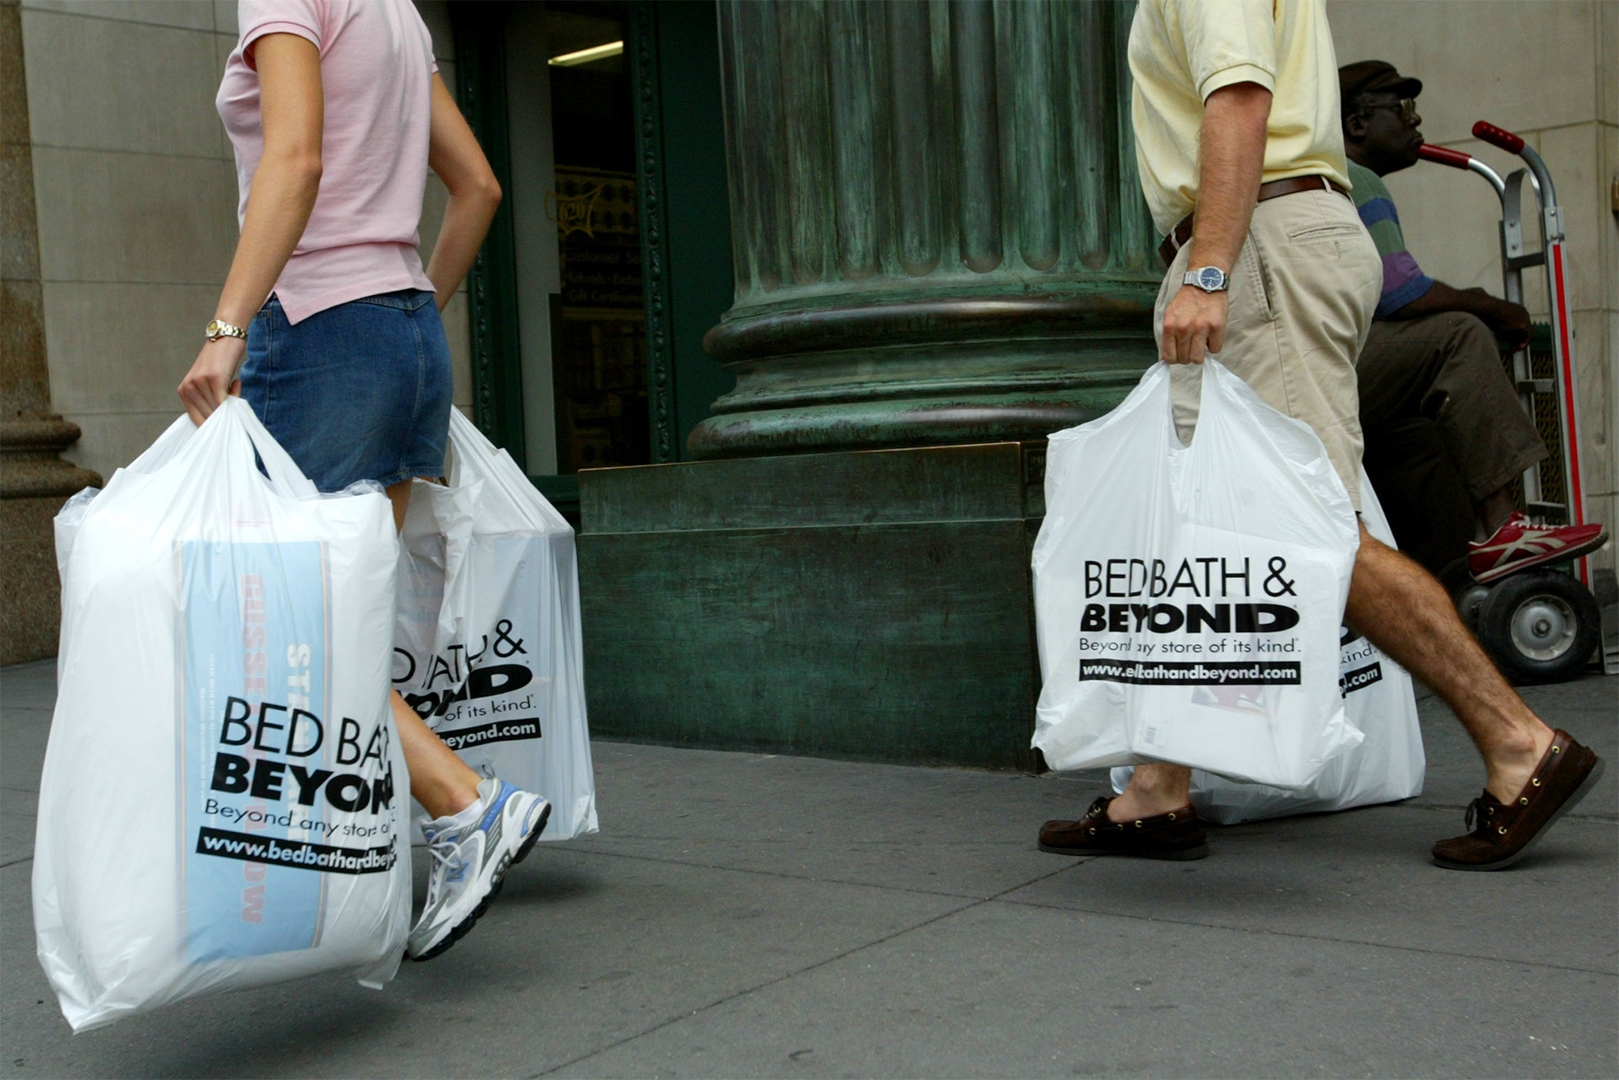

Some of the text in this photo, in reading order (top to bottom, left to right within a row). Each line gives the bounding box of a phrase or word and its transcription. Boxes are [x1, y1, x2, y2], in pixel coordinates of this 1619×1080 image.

[1084, 555, 1298, 599] BED BATH &
[493, 618, 528, 658] &
[1080, 603, 1300, 634] BEYOND
[1161, 641, 1203, 654] store
[1208, 638, 1227, 654] of
[1233, 639, 1252, 653] its
[219, 696, 325, 758] BED
[444, 704, 463, 722] of
[468, 704, 487, 718] its
[210, 751, 395, 816] BEYON
[205, 798, 293, 828] Beyond
[300, 818, 339, 838] any
[343, 823, 377, 838] stor
